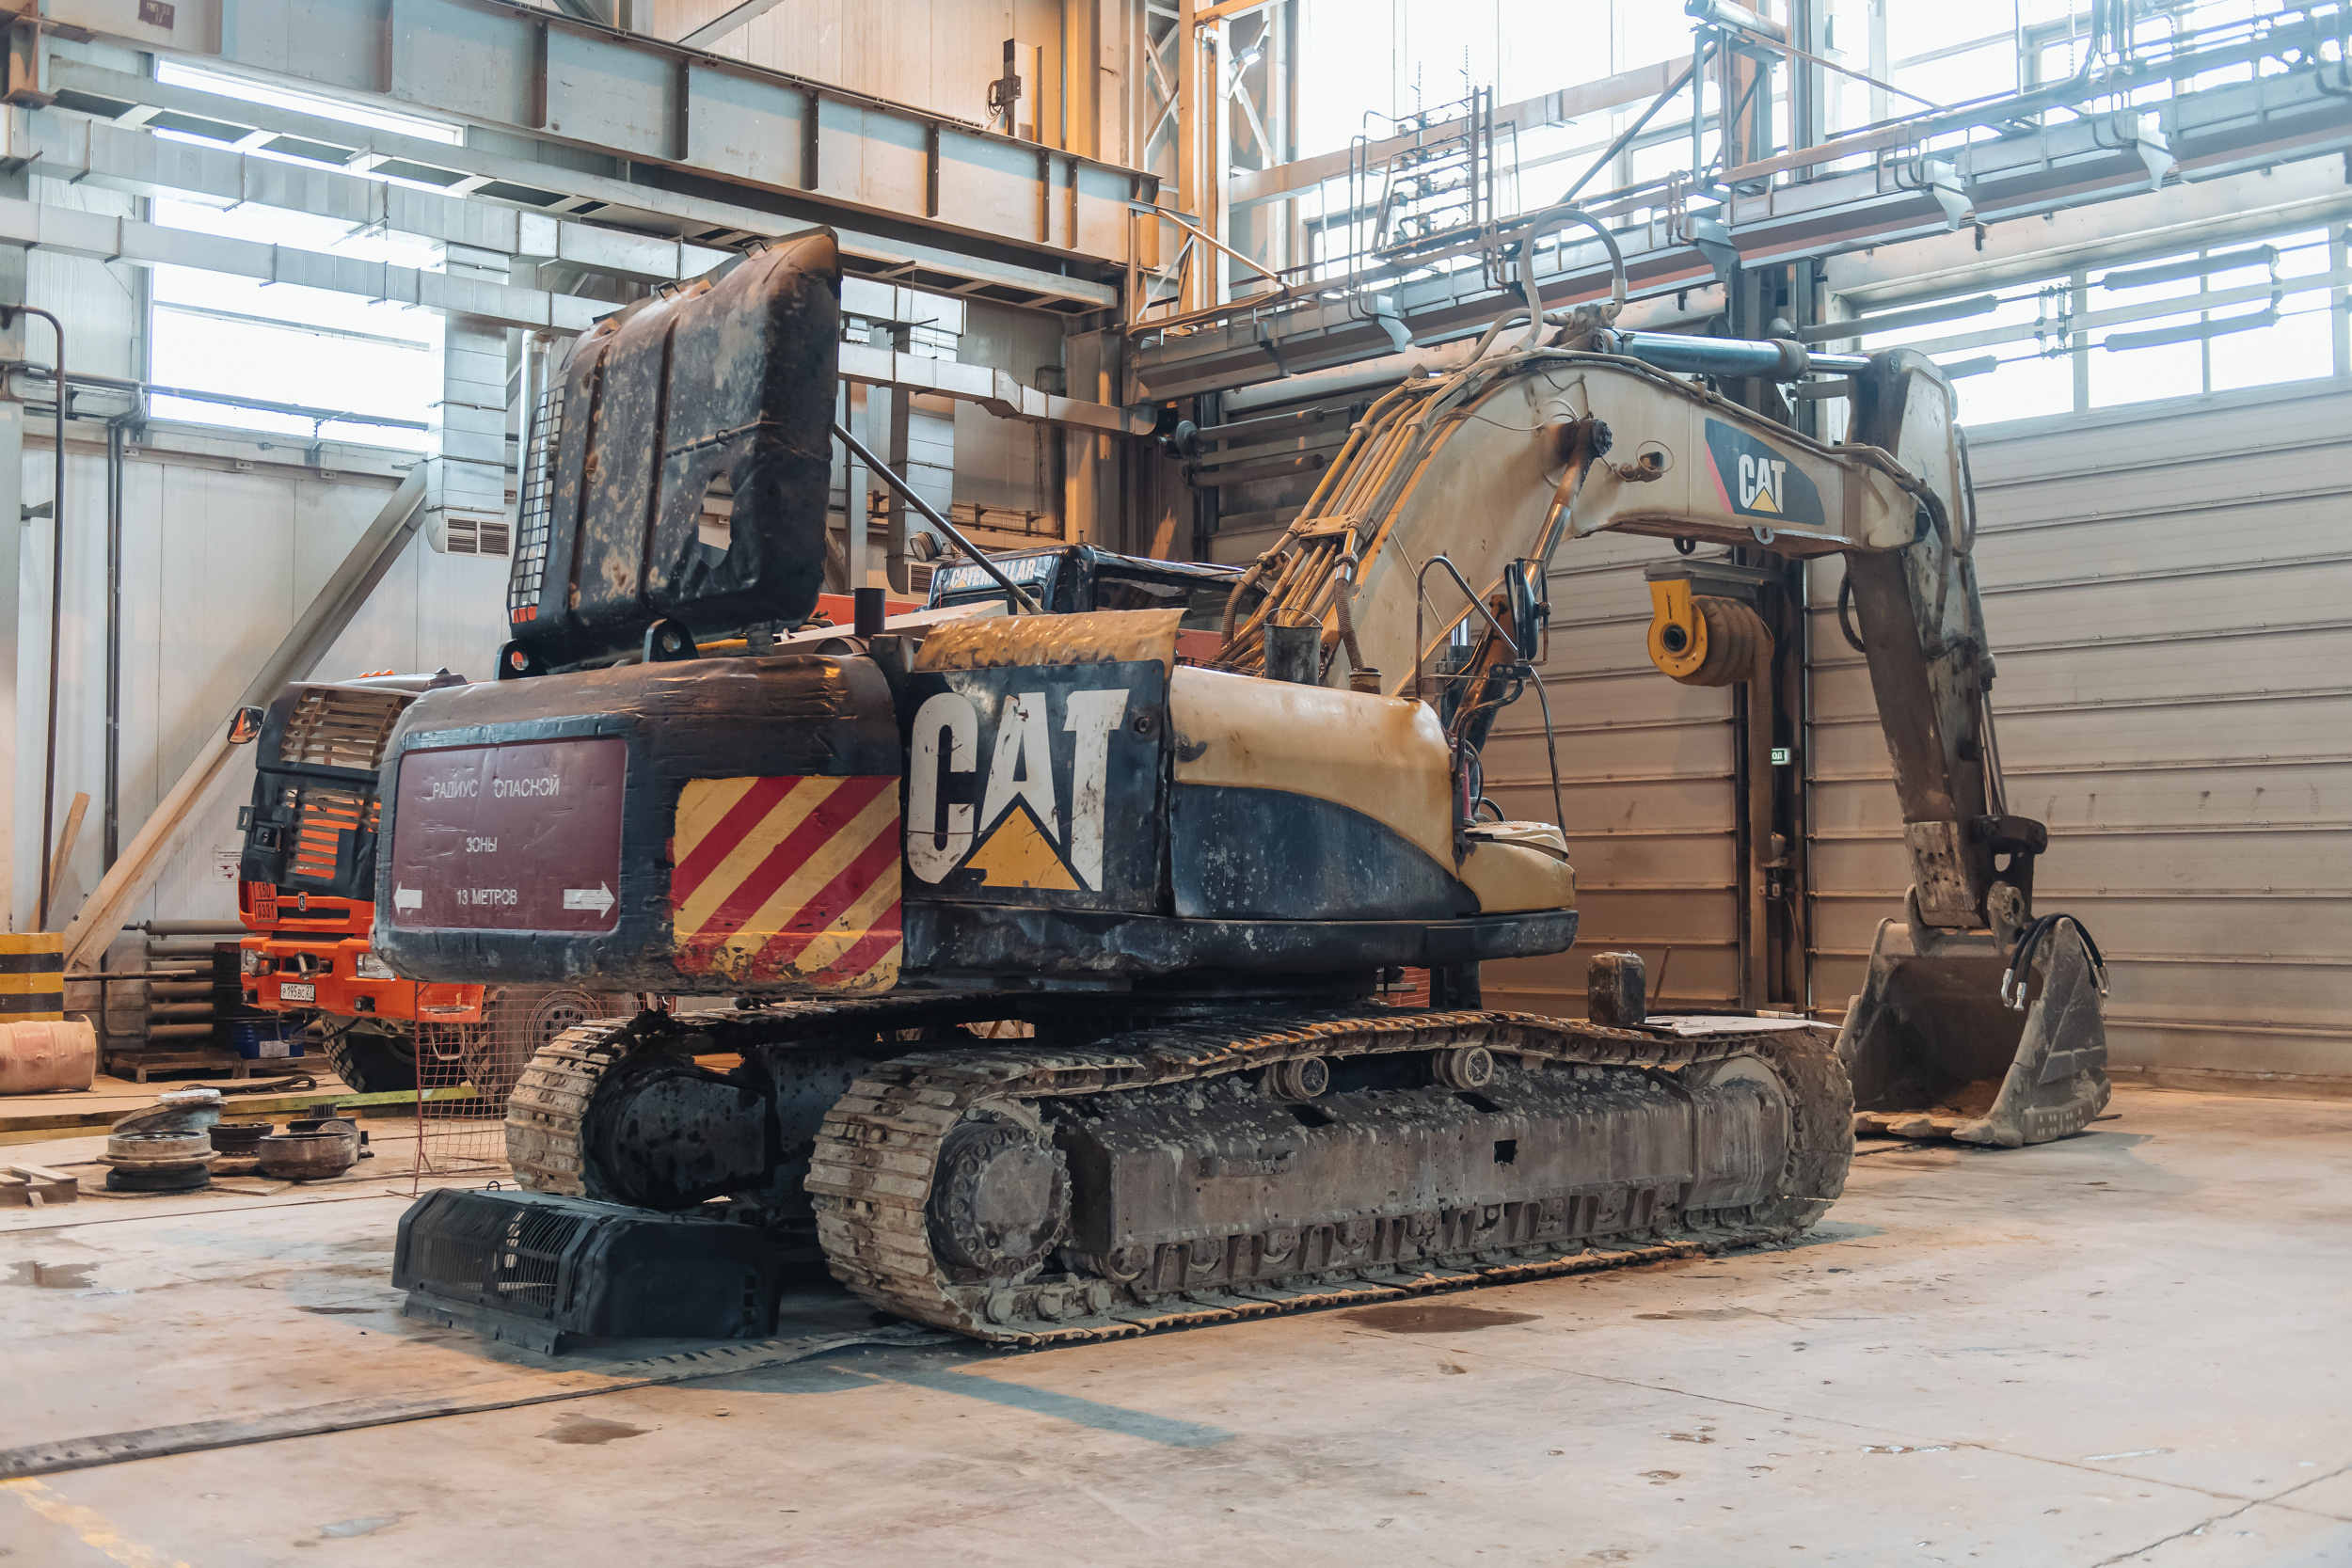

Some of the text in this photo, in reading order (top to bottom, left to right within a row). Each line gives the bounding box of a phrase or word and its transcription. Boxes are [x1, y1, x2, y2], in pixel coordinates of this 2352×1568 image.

[1739, 453, 1787, 514] CAT
[433, 773, 561, 800] РАДИУС ОПАСНОЙ
[907, 689, 1129, 892] CAT
[466, 836, 498, 853] ЗОНЫ
[456, 888, 518, 905] 13 МЕТРОВ
[258, 903, 275, 919] 0331
